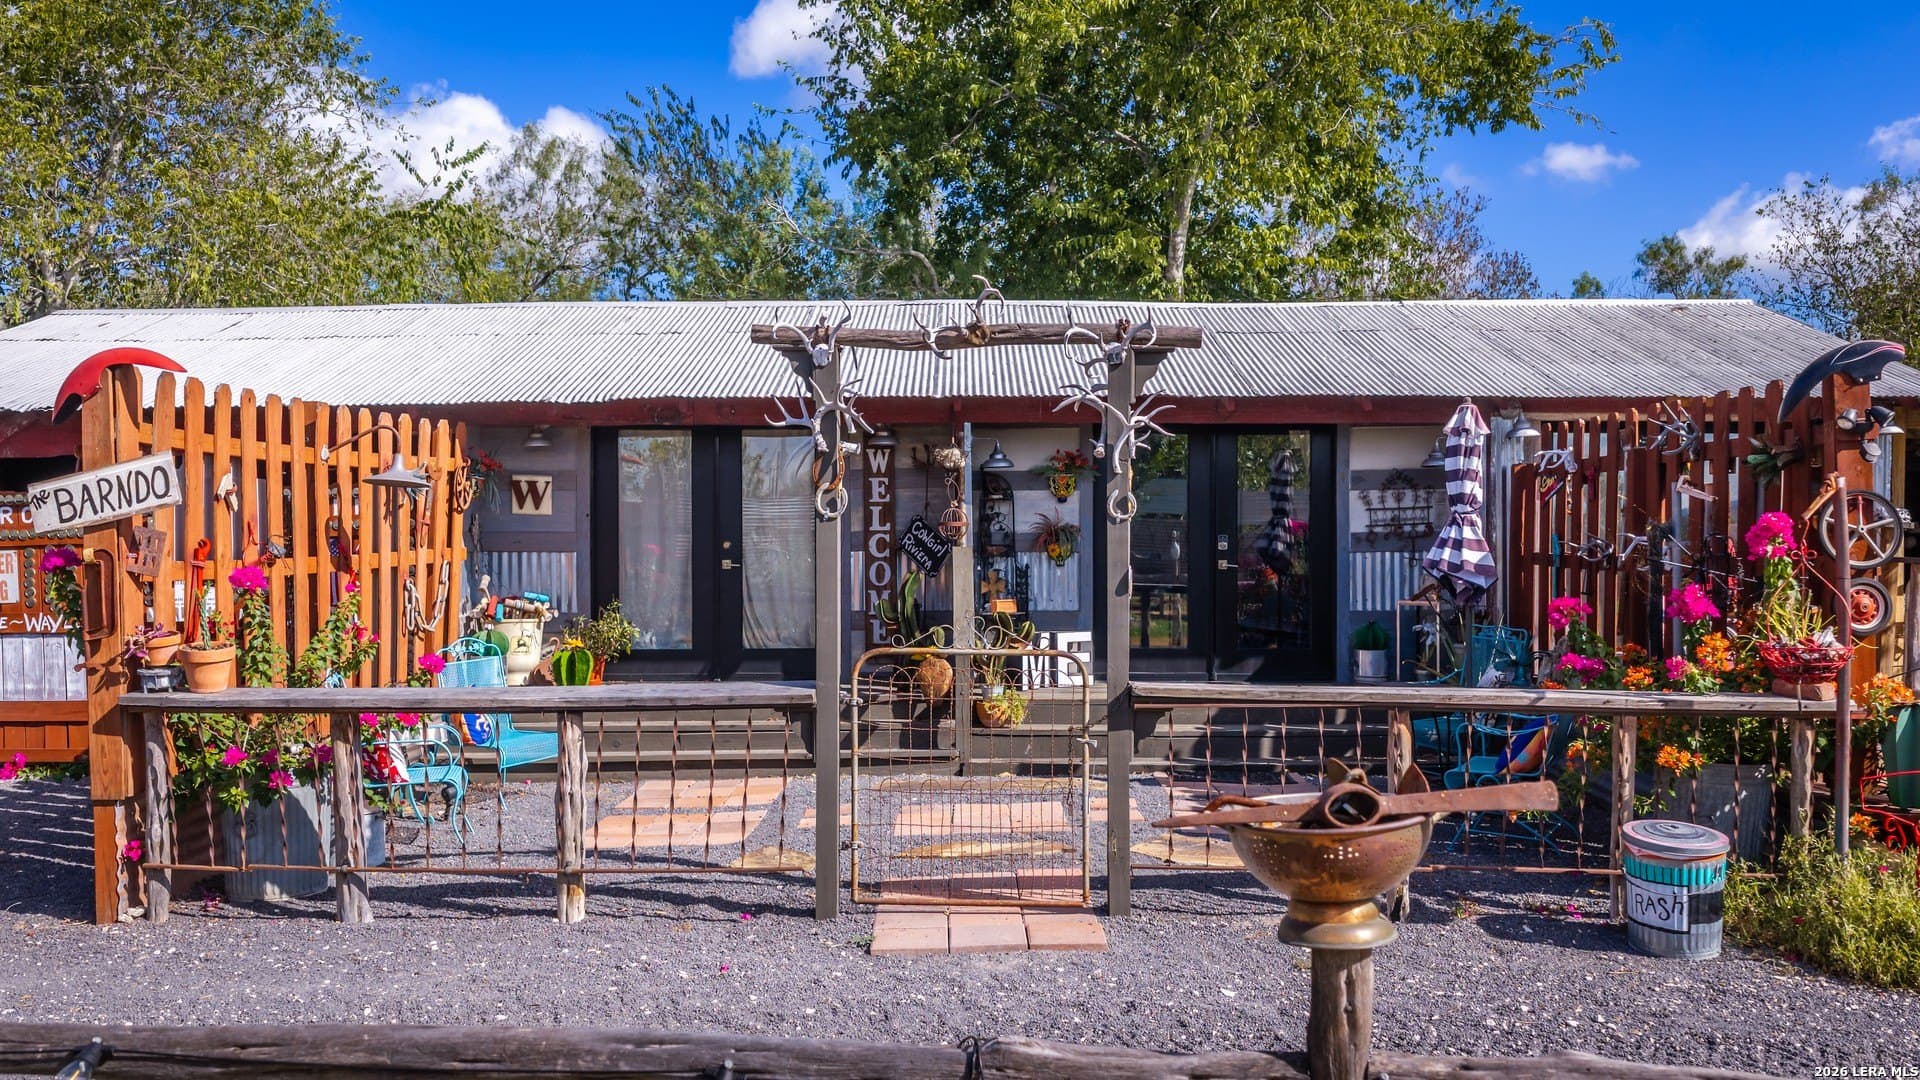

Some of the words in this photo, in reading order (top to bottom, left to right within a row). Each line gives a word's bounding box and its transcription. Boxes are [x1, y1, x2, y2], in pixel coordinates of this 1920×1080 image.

[54, 465, 171, 524] BARNDO
[512, 480, 550, 510] W
[866, 449, 892, 644] WELCOME
